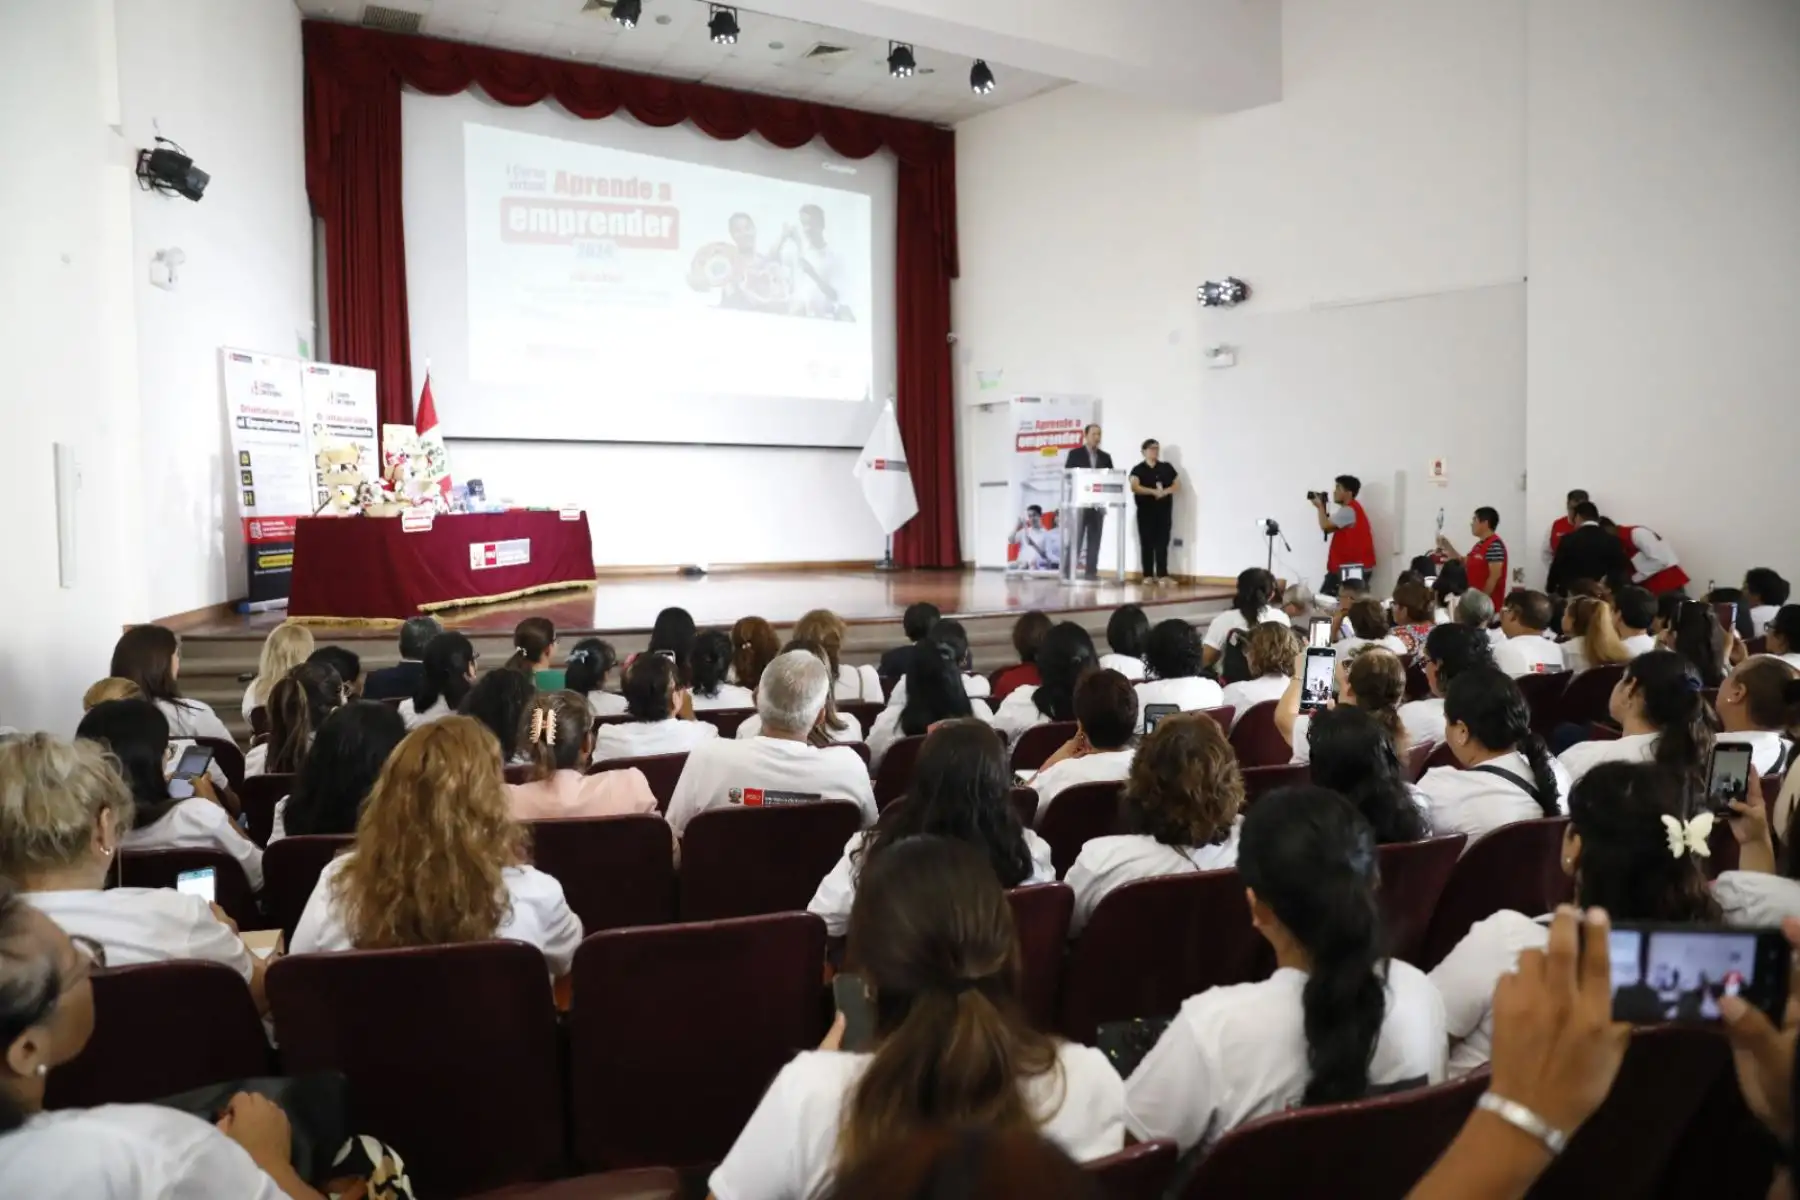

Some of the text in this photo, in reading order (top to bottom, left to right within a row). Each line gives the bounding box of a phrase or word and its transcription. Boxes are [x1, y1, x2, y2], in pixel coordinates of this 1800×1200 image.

[554, 170, 671, 200] Aprende a
[509, 205, 673, 238] emprender
[1036, 418, 1073, 430] Aprende
[1018, 432, 1081, 448] emprender
